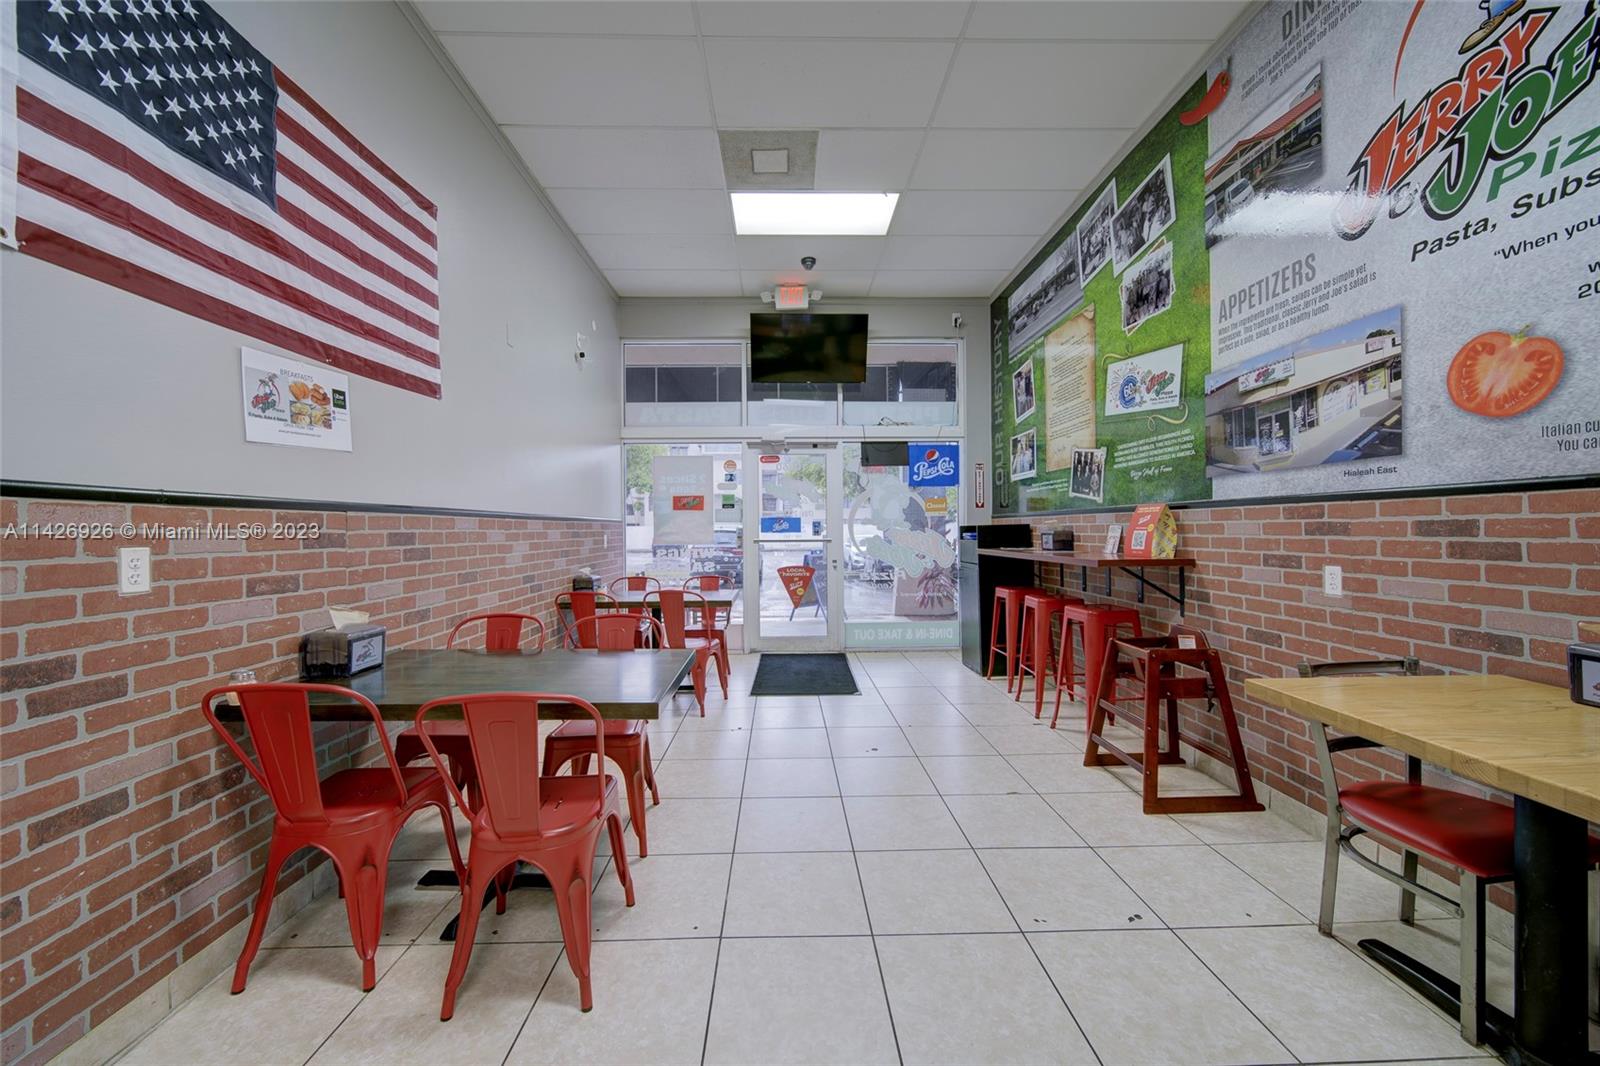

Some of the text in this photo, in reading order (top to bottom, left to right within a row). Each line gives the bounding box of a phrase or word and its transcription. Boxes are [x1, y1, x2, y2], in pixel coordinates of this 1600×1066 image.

[1332, 8, 1560, 240] JERRY
[1411, 166, 1600, 262] Pasta, Subs
[1219, 253, 1316, 323] APPETIZERS
[1302, 297, 1318, 311] Jerry
[1318, 291, 1329, 303] and
[1331, 284, 1348, 298] Joe's
[1349, 274, 1368, 290] salad
[1369, 272, 1377, 282] is
[1311, 283, 1322, 295] can
[1324, 279, 1331, 290] be
[1332, 268, 1355, 286] simple
[1355, 263, 1366, 277] yet
[1312, 303, 1329, 317] lunch
[994, 318, 1003, 425] HISTORY
[1541, 422, 1581, 438] Italian
[1557, 436, 1600, 451] You ca
[995, 431, 1004, 486] OUR
[1343, 466, 1398, 477] Hialeah East
